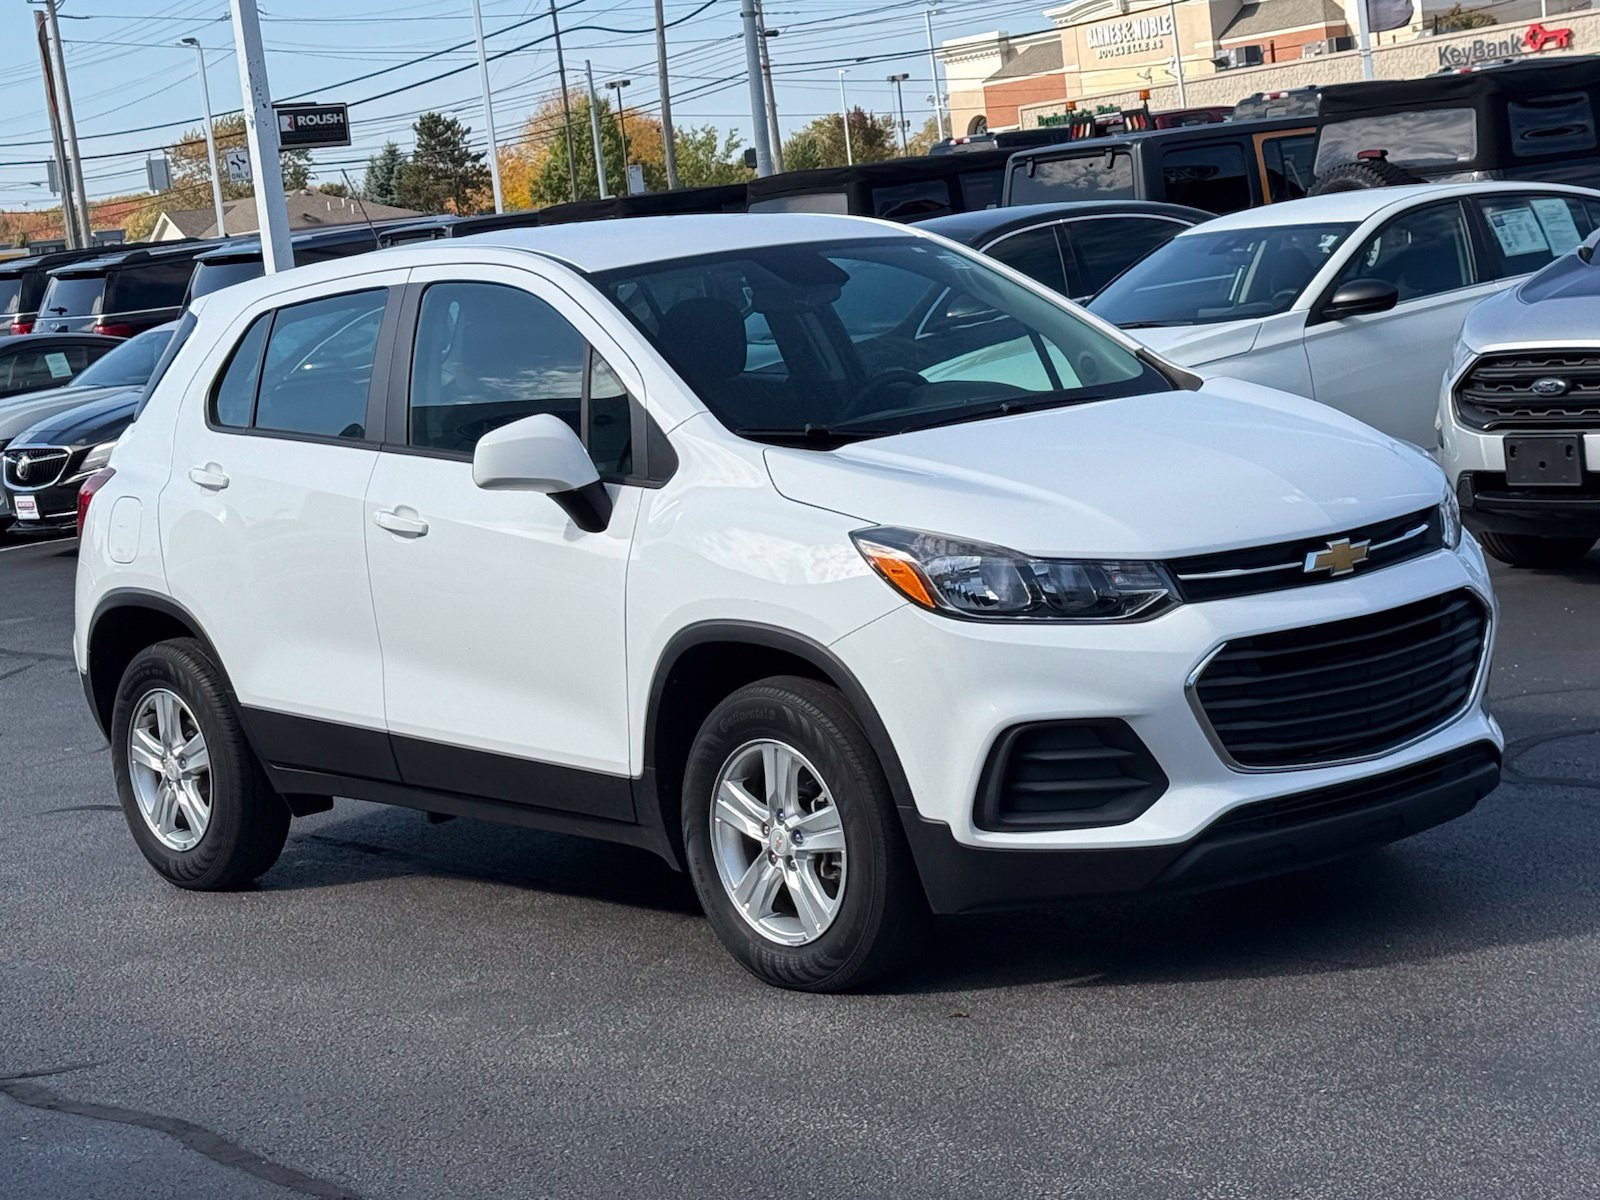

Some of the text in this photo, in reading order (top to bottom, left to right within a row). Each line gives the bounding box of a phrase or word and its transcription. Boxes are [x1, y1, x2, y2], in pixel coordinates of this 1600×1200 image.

[1438, 34, 1522, 66] KeyBank
[297, 113, 344, 127] ROUSH
[231, 171, 249, 180] ONLY
